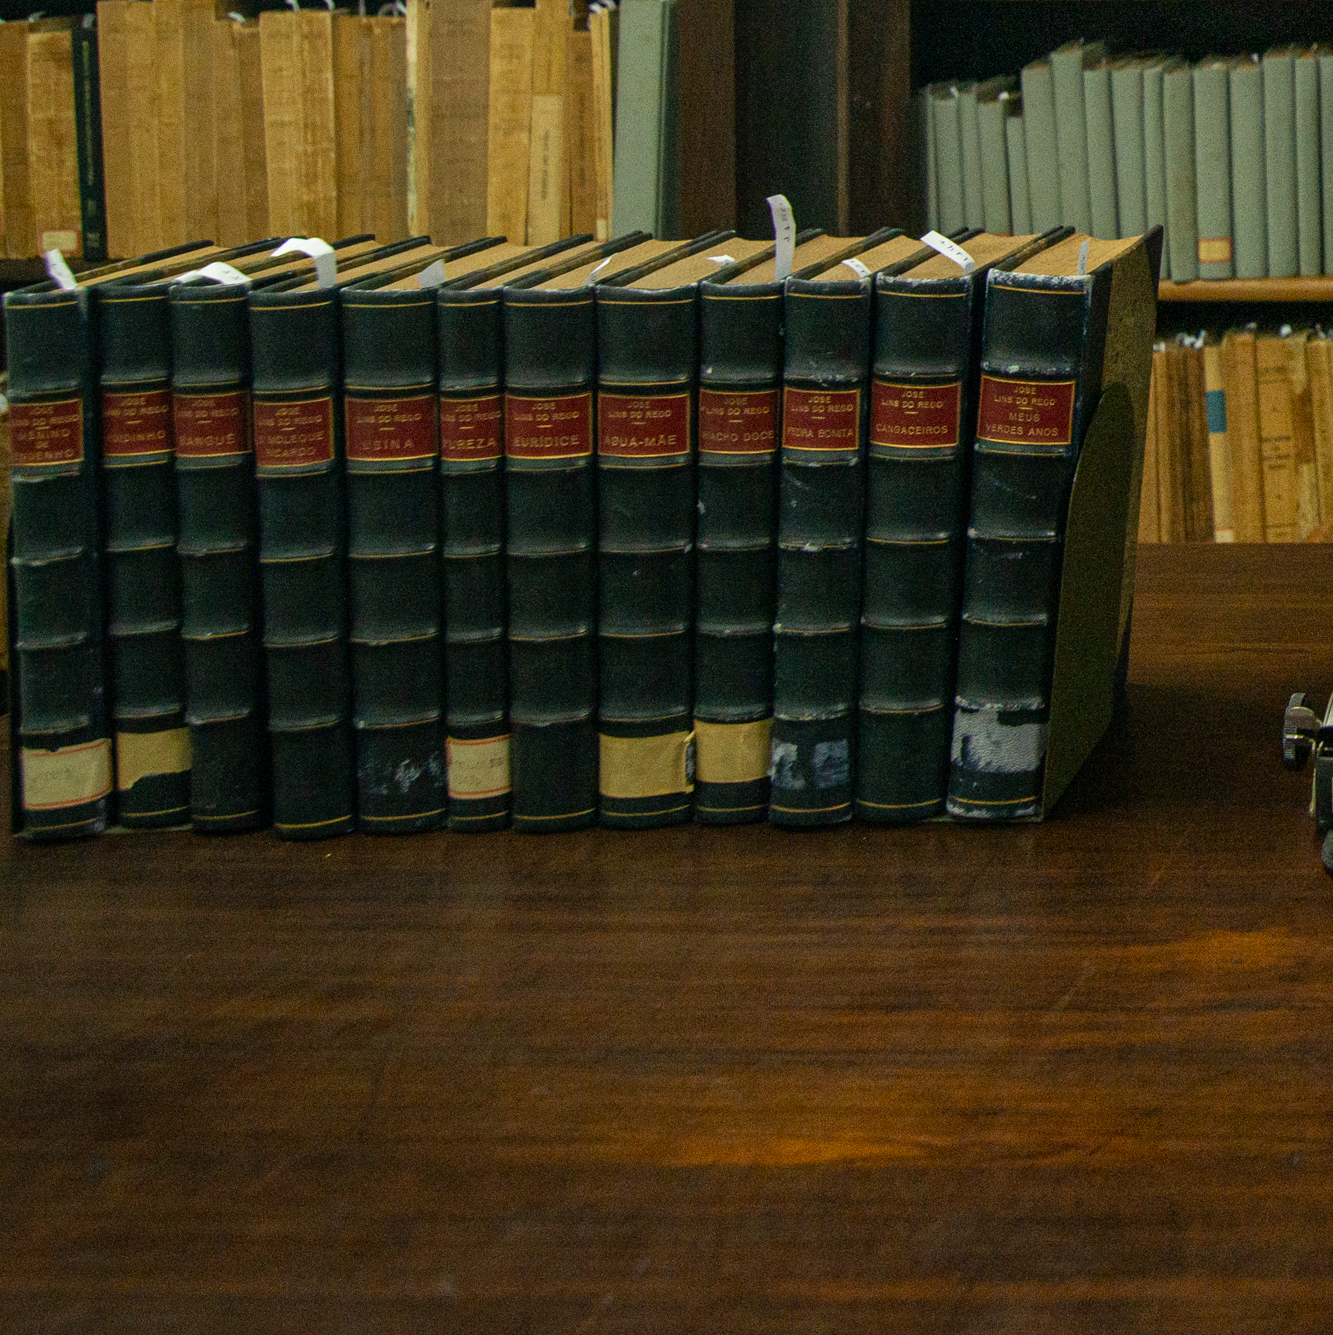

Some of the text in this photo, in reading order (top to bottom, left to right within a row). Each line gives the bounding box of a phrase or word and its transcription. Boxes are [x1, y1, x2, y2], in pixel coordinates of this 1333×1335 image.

[1016, 397, 1028, 405] DO
[1031, 398, 1056, 406] REGO
[1009, 412, 1040, 422] MEUS
[787, 426, 855, 438] PEDRA BONITA
[876, 423, 948, 435] CANGACEIROS
[986, 423, 1059, 437] VERDES ANOS
[267, 431, 324, 445] MOLEQUE
[744, 430, 774, 441] DOCE
